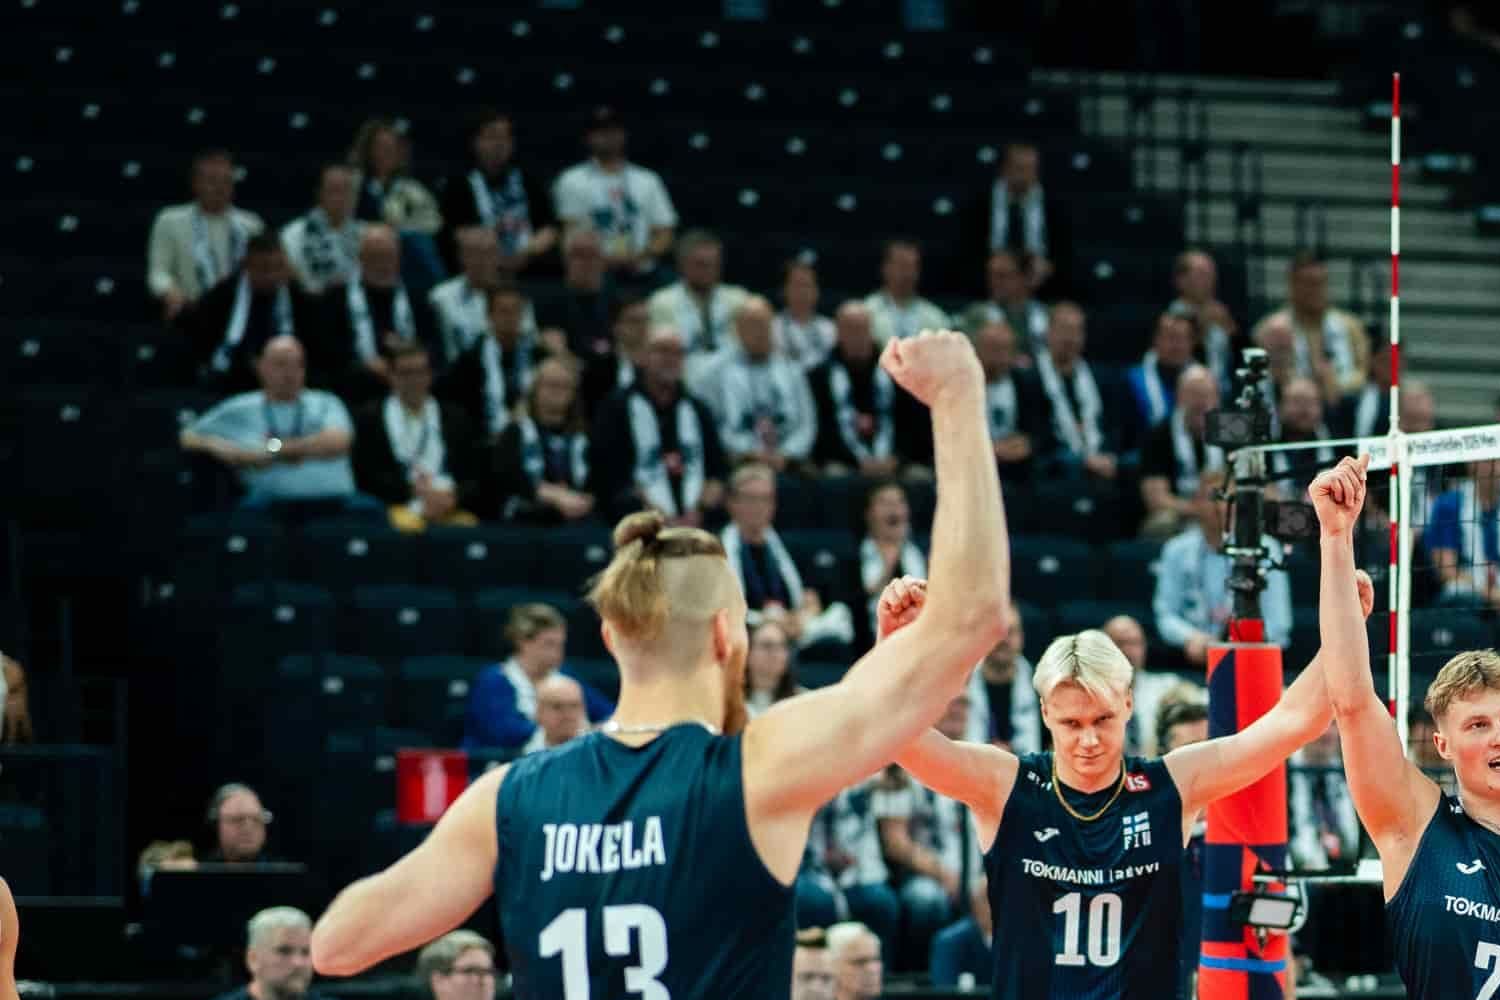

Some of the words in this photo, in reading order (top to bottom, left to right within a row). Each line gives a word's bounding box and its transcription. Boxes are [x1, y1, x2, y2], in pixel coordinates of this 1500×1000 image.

[540, 816, 667, 882] JOKELA
[1022, 858, 1104, 884] TOKMANNI
[1052, 891, 1123, 967] 10
